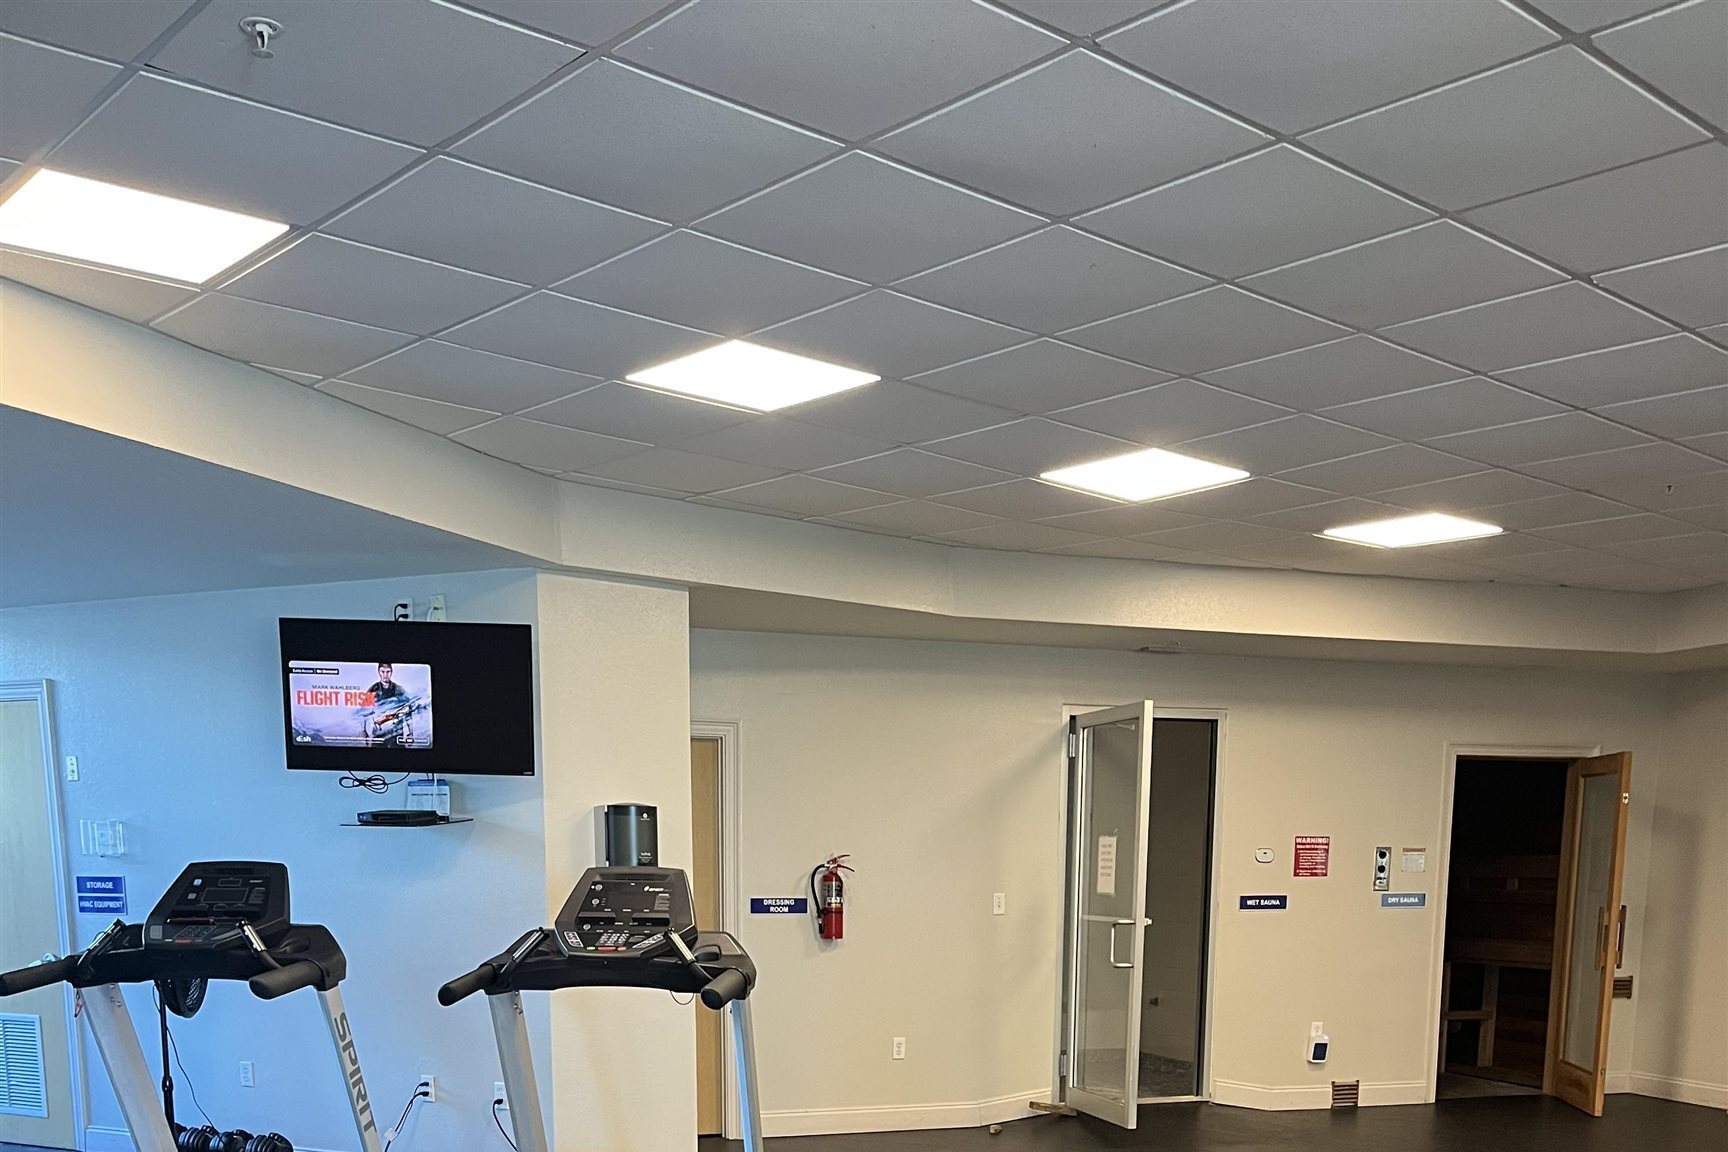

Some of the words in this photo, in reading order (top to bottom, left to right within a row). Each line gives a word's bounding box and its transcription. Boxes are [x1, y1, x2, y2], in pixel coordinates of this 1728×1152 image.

[296, 690, 340, 706] FLIGHT
[344, 691, 376, 707] RISK
[86, 881, 114, 889] STORAGE
[79, 900, 94, 908] HVAC
[94, 900, 124, 908] EQUIPMENT
[1399, 896, 1419, 904] SAUNA
[333, 1011, 377, 1134] SPIRIT
